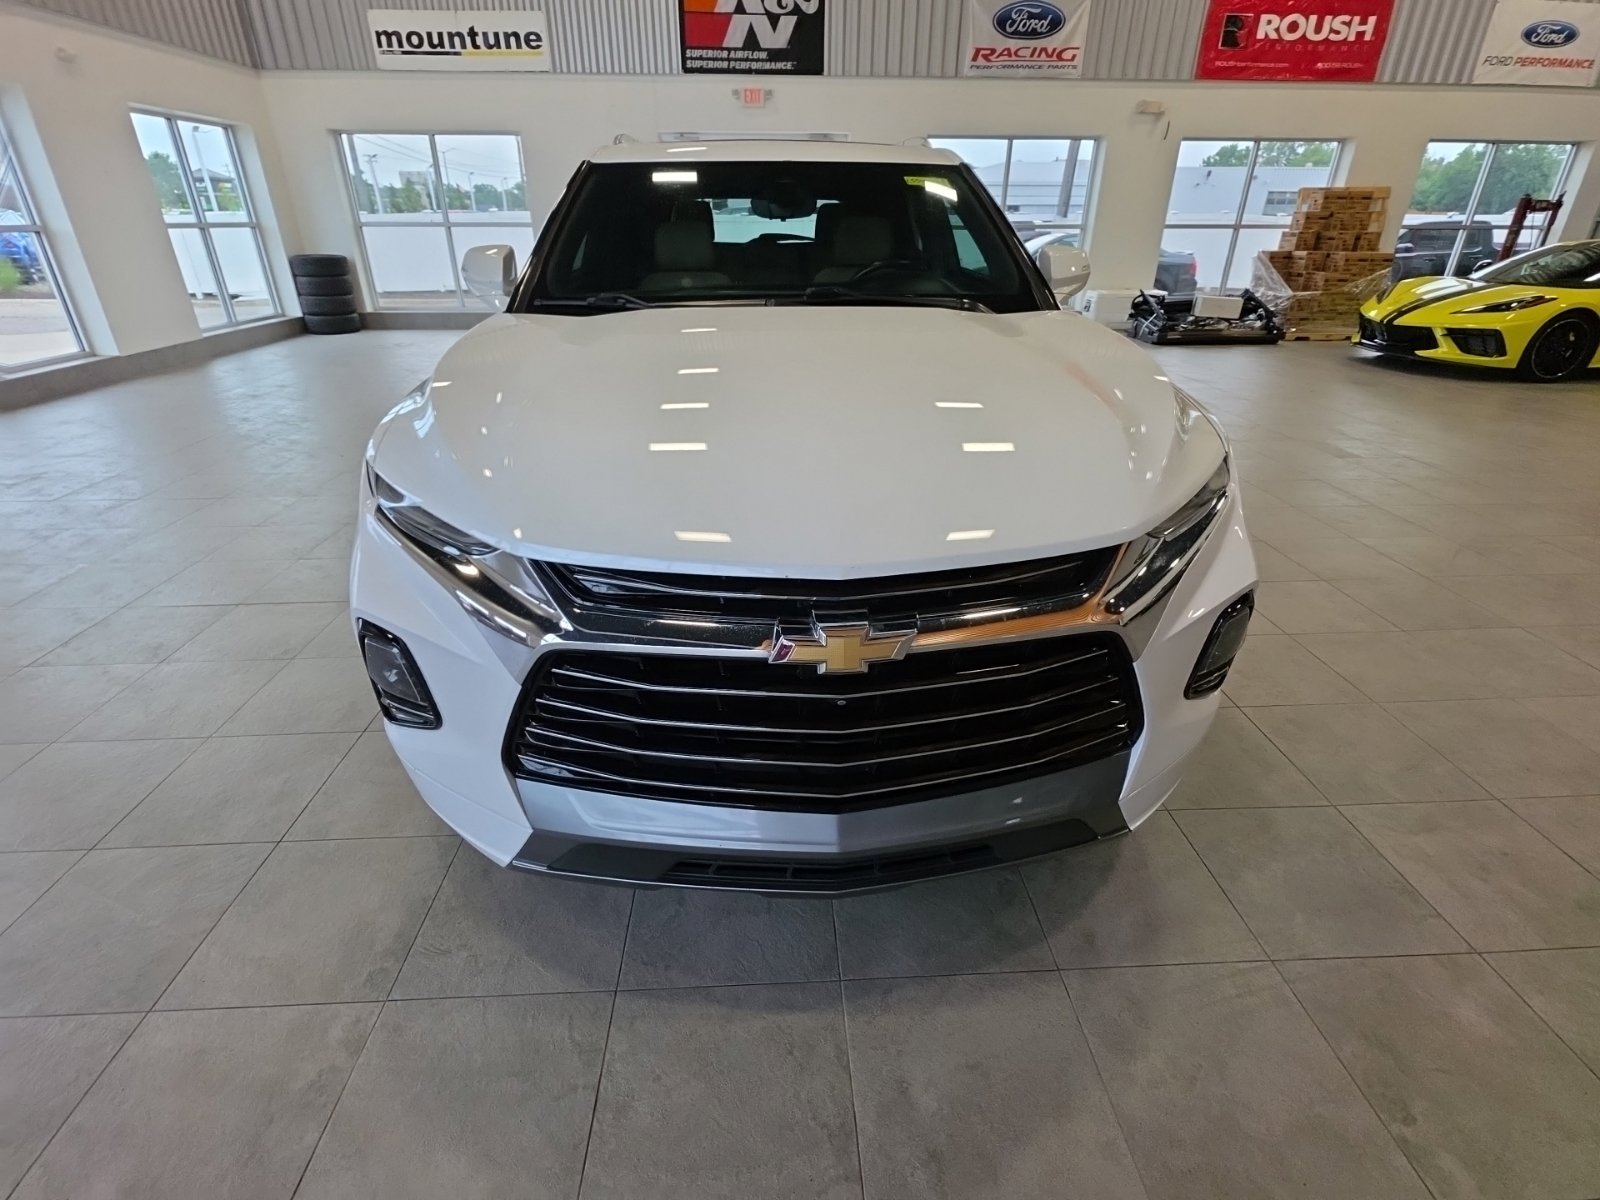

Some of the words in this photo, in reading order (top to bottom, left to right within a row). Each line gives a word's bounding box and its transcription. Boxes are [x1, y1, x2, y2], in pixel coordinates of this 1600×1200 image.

[1005, 6, 1053, 33] Ford
[1256, 13, 1377, 41] ROUSH
[374, 25, 543, 50] mountune
[1531, 24, 1569, 43] Ford
[685, 49, 729, 58] SUPERIOR
[729, 50, 769, 60] AIRFLOW.
[970, 46, 1080, 63] RACING
[1481, 55, 1514, 67] FORD
[1513, 56, 1595, 69] PERFORMANCE
[685, 59, 729, 69] SUPERIOR
[744, 88, 761, 104] EXIT
